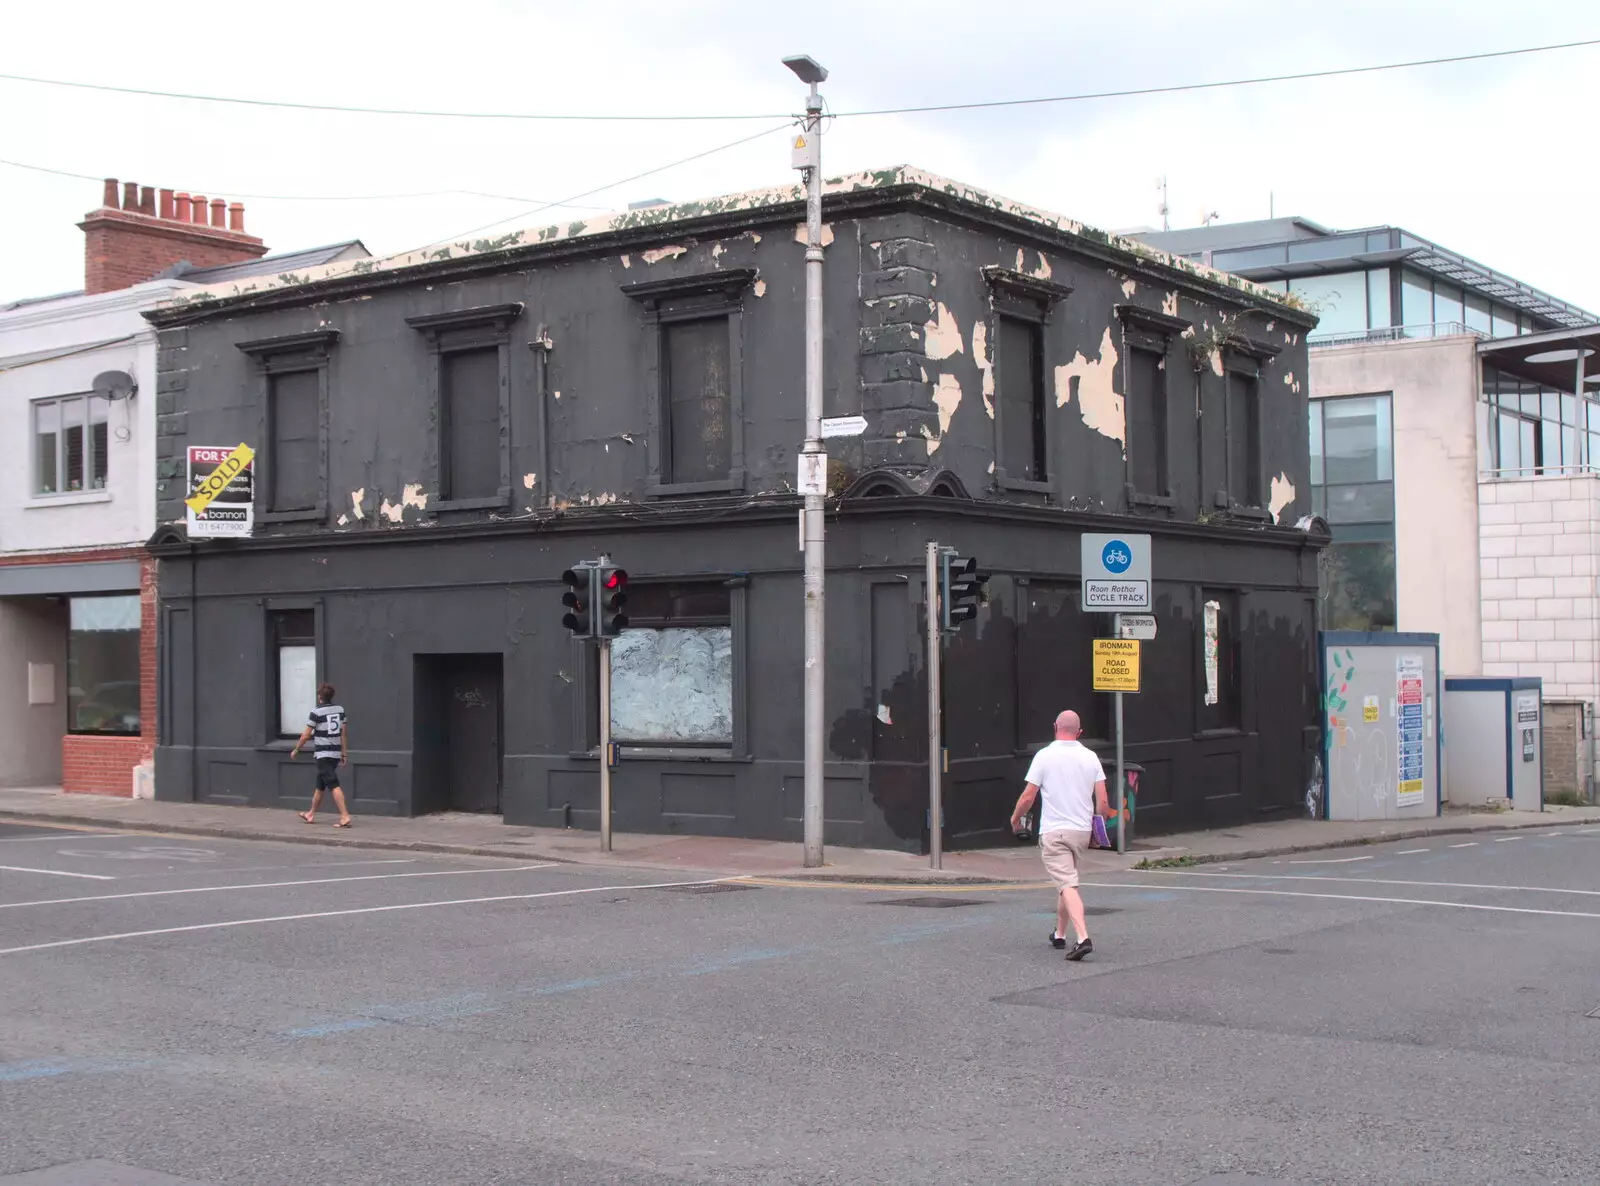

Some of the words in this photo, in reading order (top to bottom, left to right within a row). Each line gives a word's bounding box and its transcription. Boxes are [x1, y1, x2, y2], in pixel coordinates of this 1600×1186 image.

[195, 451, 218, 460] FOR
[199, 458, 240, 500] SOLD
[209, 510, 246, 519] bannon
[198, 523, 208, 531] 01
[1102, 667, 1130, 675] CLOSED
[330, 716, 339, 731] 5
